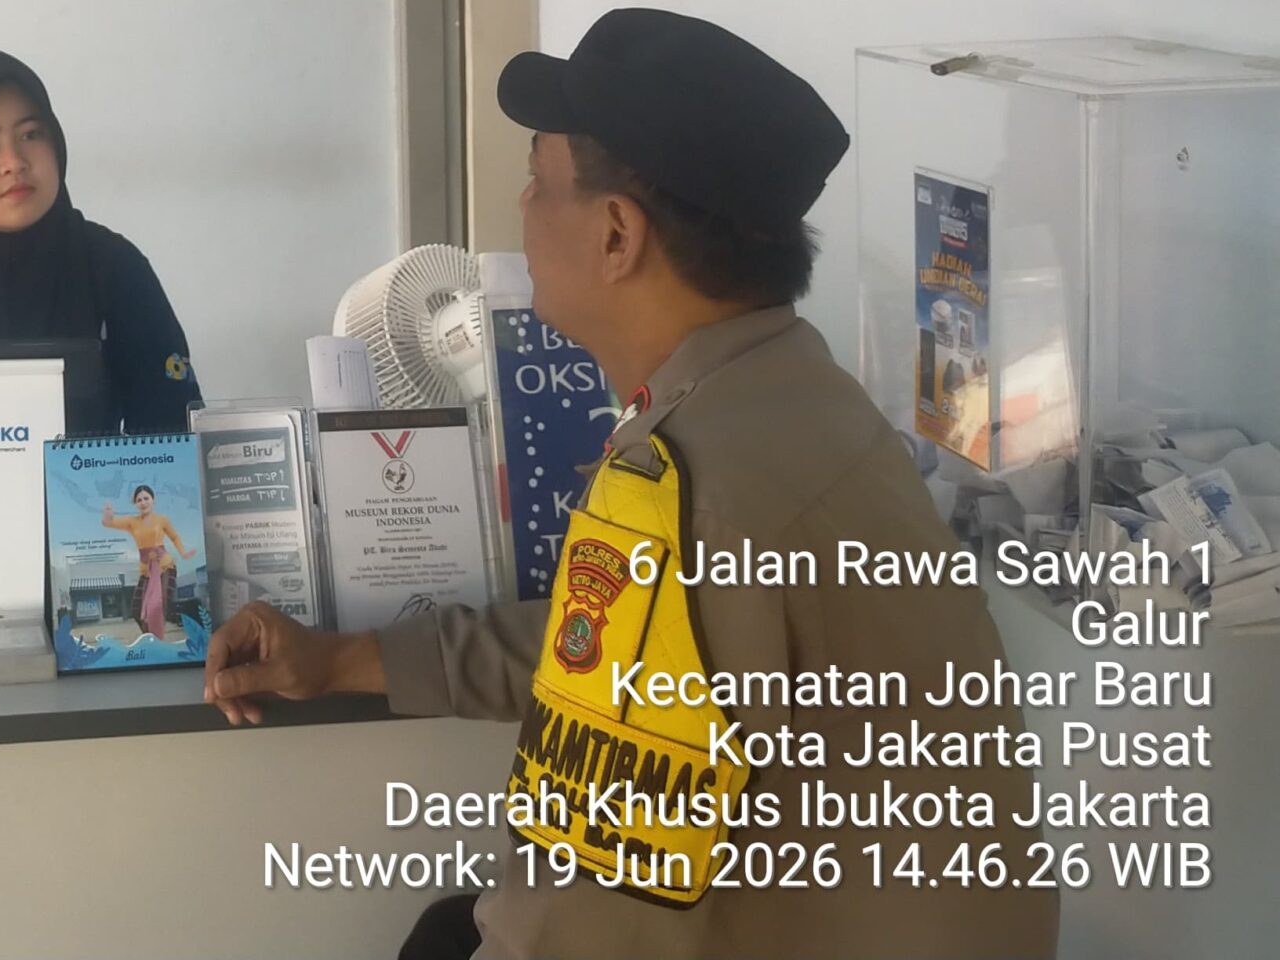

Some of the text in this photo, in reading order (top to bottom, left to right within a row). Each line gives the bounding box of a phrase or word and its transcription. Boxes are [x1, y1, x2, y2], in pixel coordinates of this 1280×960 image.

[243, 444, 273, 458] Biru
[84, 458, 106, 469] Biru
[120, 453, 174, 466] Indonesia
[254, 471, 277, 483] TOP
[345, 504, 460, 518] MUSEUM REKOR DUNIA
[376, 516, 432, 527] INDONESIA
[577, 544, 621, 570] POLRES
